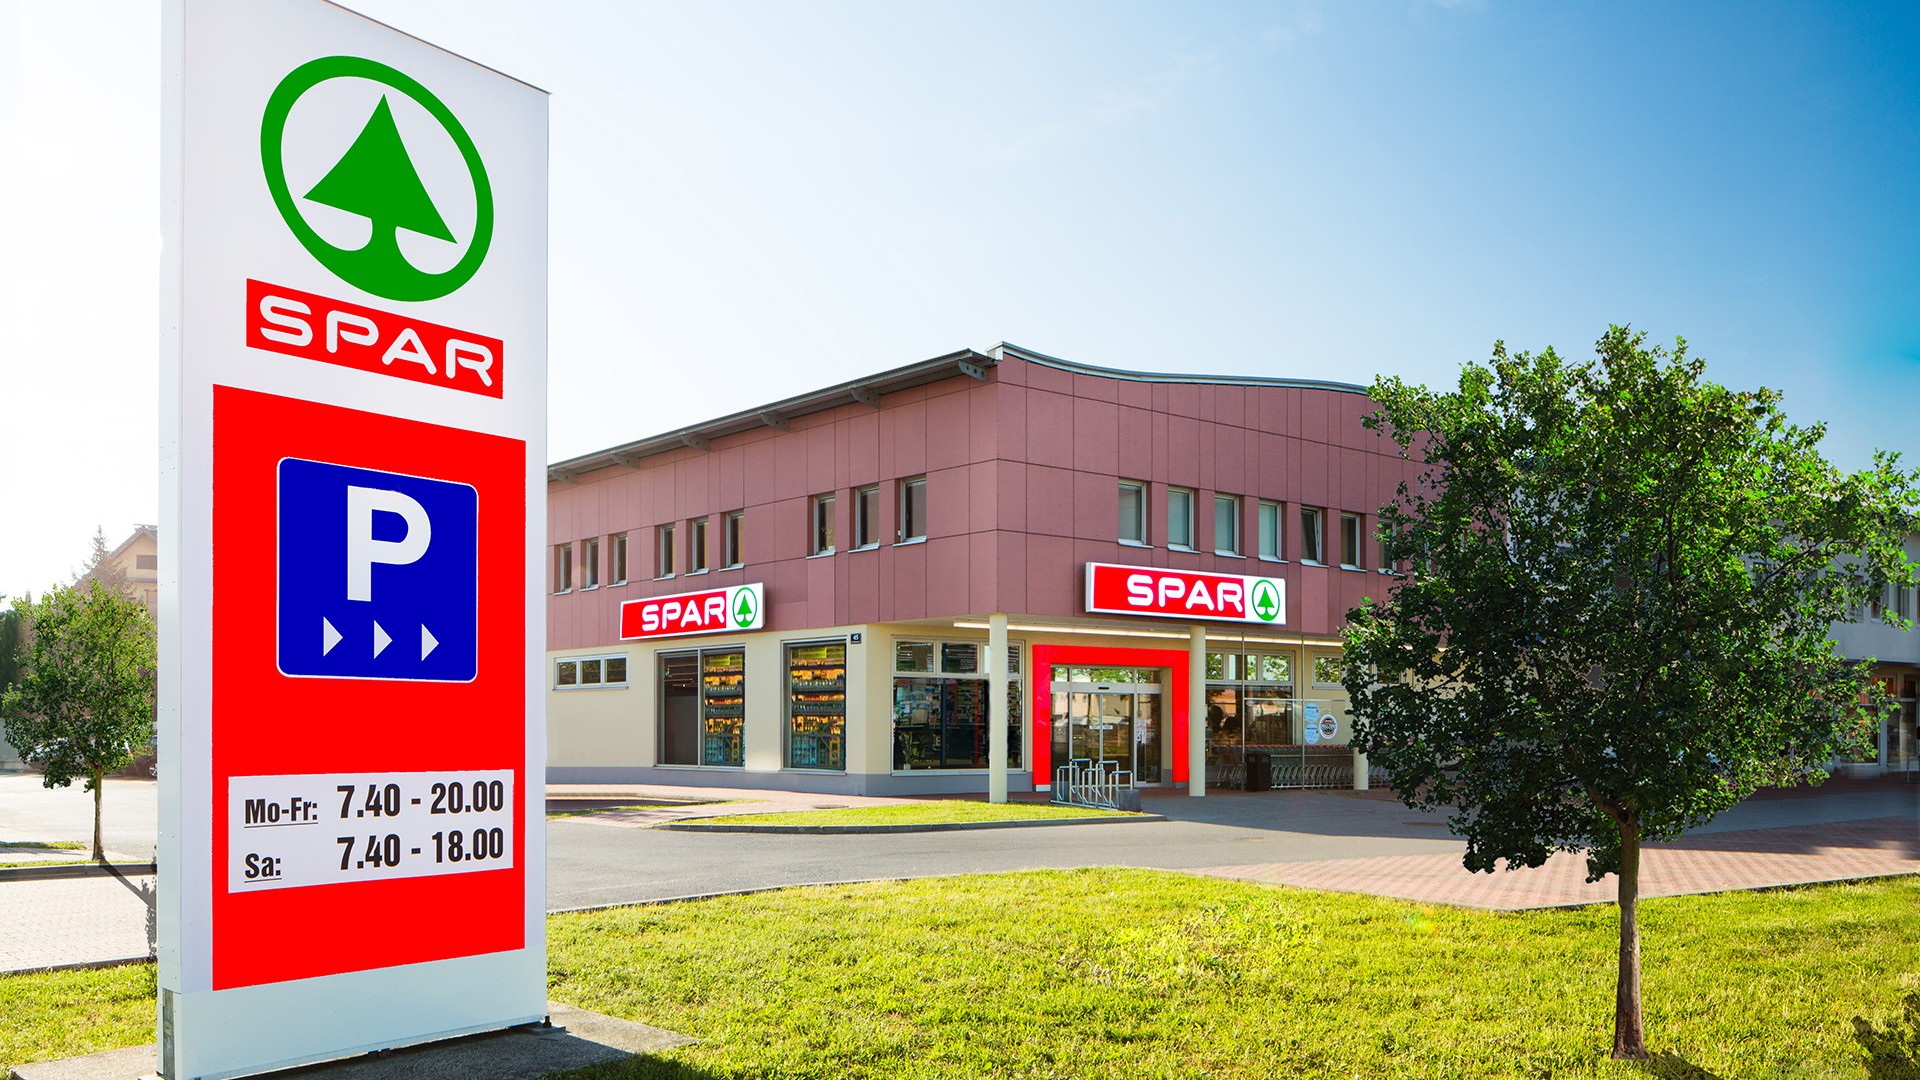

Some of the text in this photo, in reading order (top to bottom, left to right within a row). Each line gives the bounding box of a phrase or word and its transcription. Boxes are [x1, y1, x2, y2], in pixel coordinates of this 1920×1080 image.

[260, 295, 494, 387] SPAR
[348, 485, 432, 602] P
[642, 596, 726, 632] SPAR
[1127, 574, 1243, 613] SPAR
[245, 797, 318, 824] Mo-Fr:
[337, 783, 400, 819] 7.40
[431, 780, 504, 815] 20.00
[244, 853, 281, 879] Sa:
[337, 833, 400, 871] 7.40
[432, 827, 504, 863] 18.00
